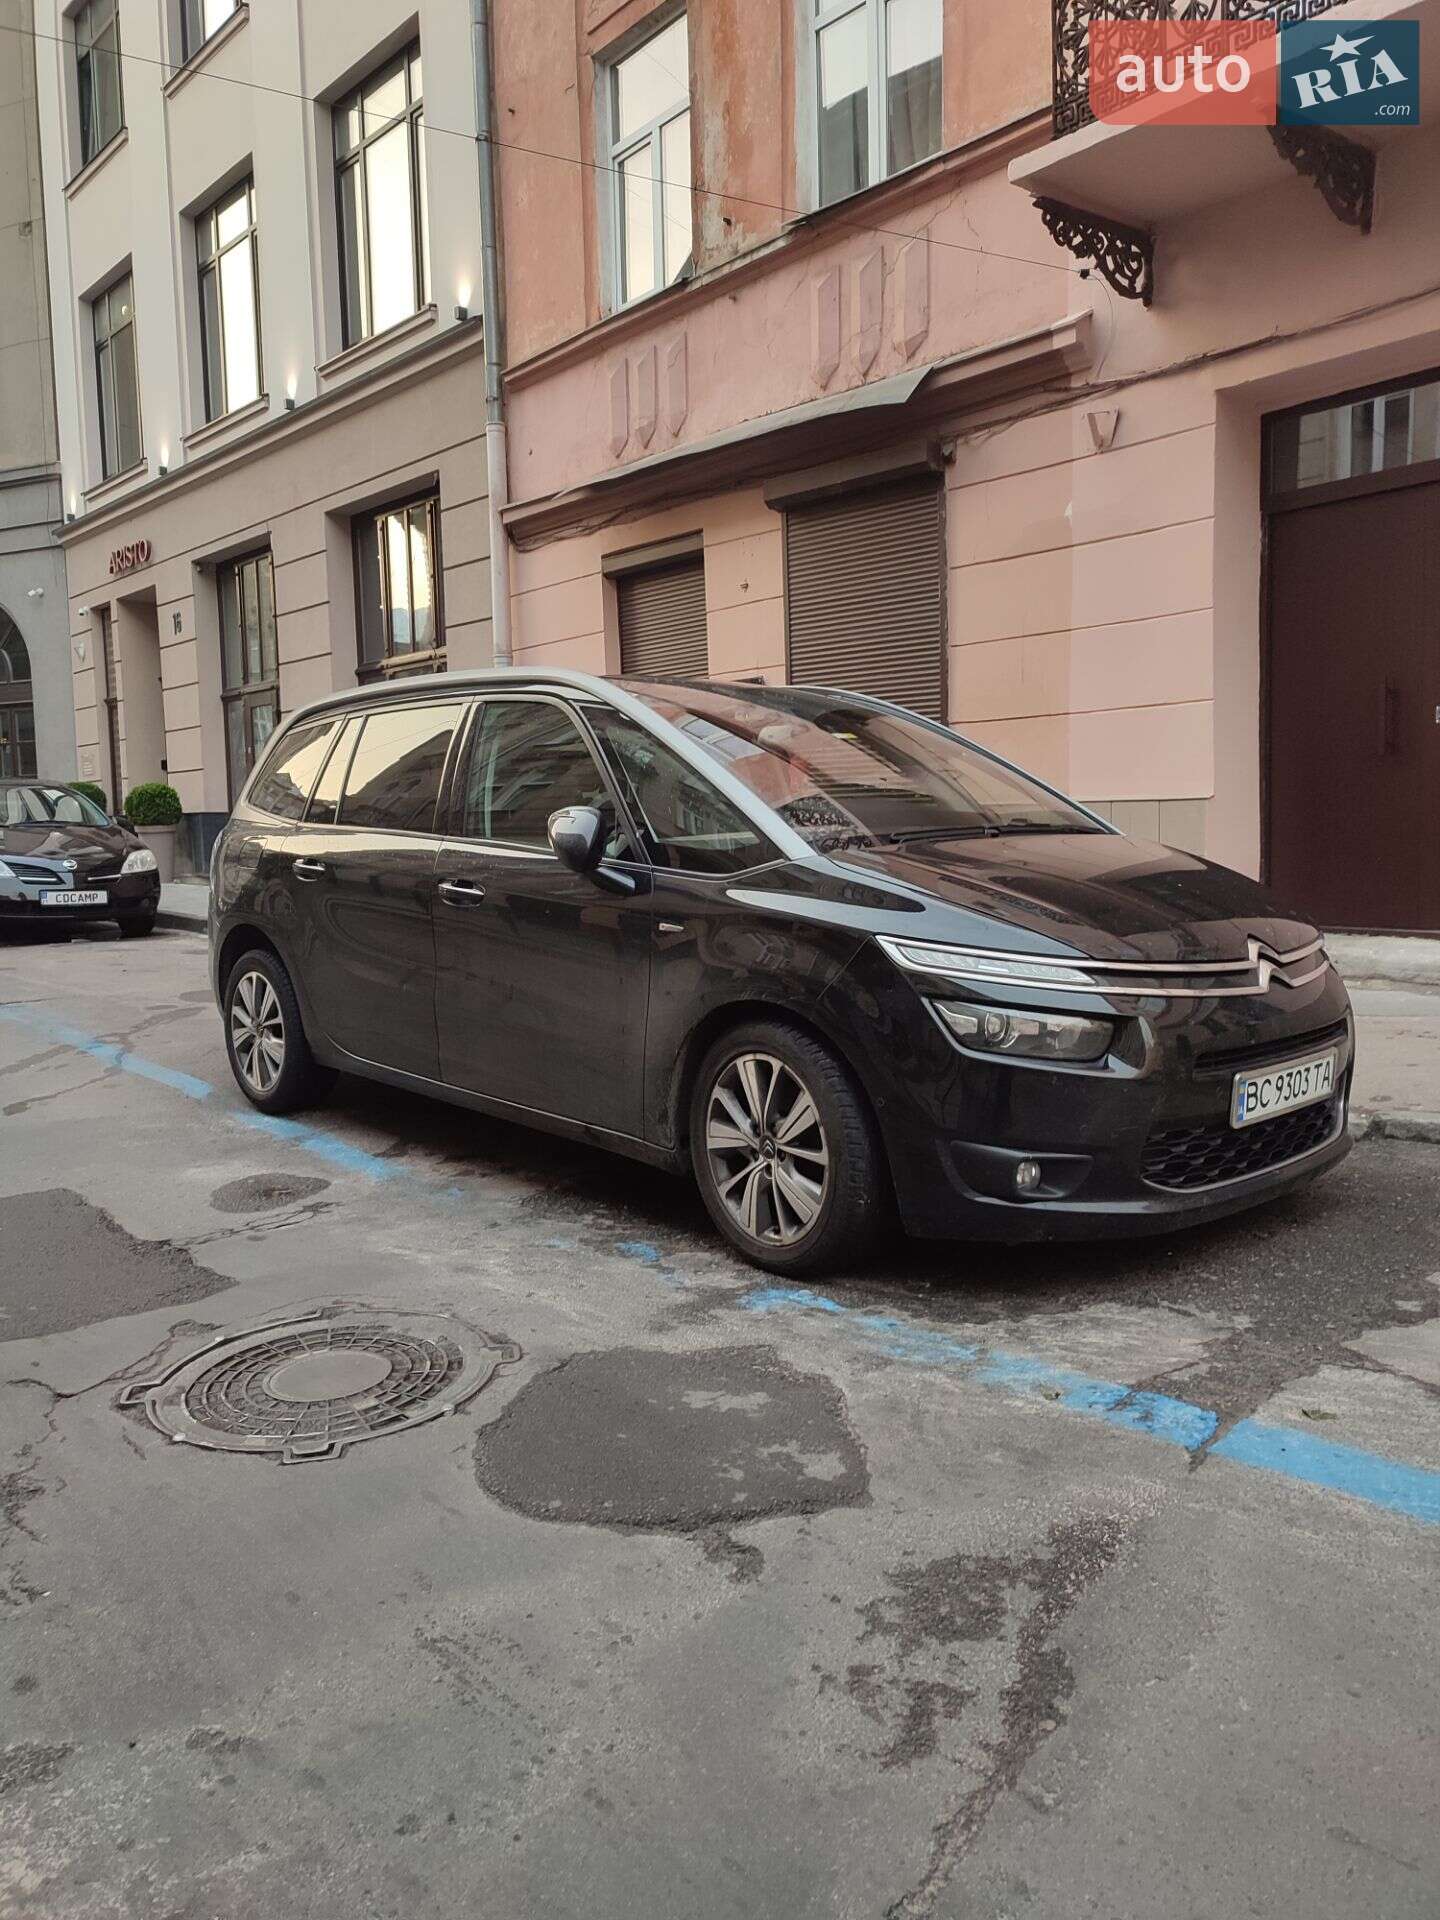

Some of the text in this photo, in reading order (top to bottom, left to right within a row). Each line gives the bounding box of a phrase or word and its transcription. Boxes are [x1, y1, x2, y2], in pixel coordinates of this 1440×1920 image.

[109, 539, 152, 574] ARISTO
[1246, 1060, 1331, 1113] BC 9303 TA
